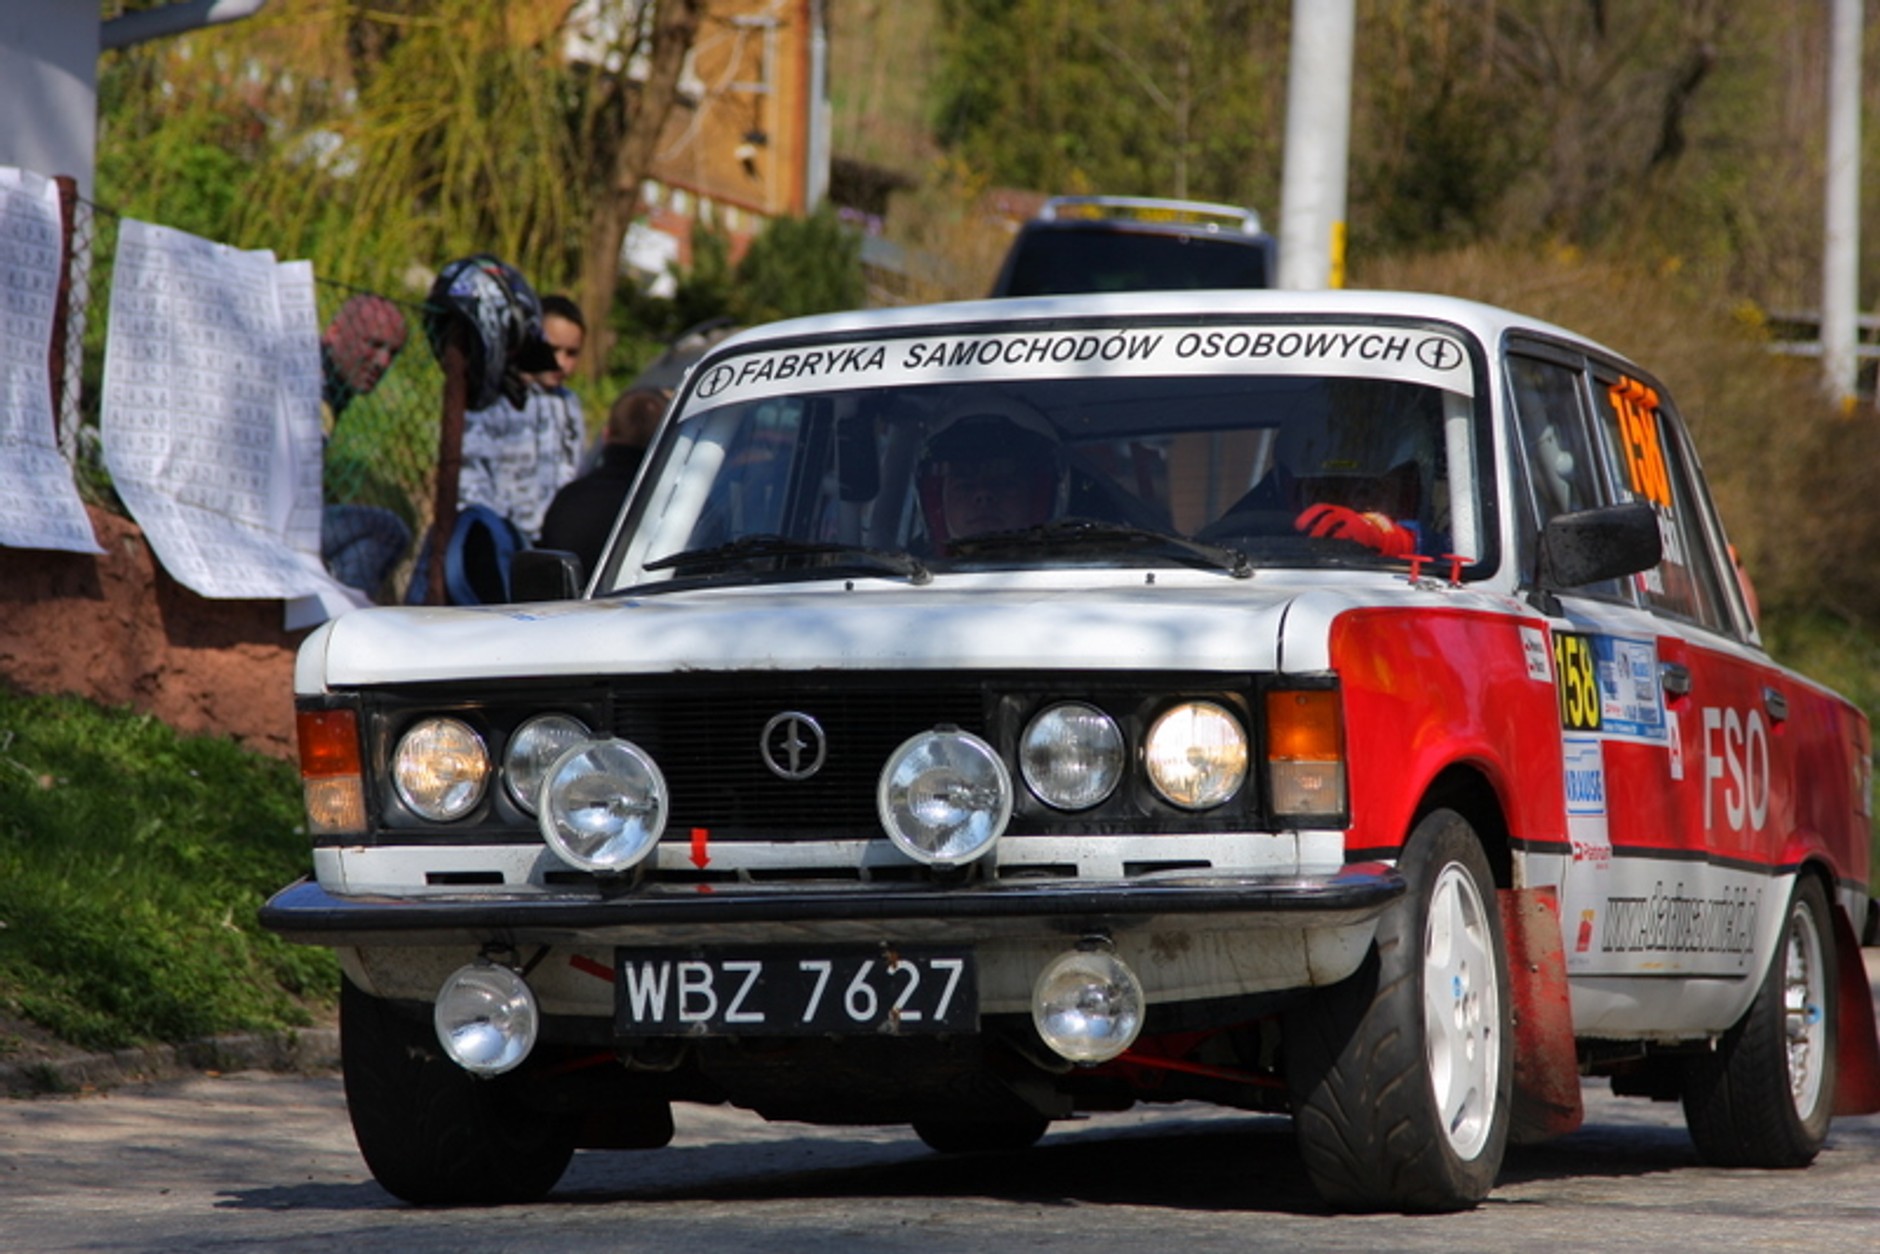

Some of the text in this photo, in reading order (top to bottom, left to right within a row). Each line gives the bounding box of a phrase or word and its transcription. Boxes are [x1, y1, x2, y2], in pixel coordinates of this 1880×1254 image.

[734, 329, 1411, 387] FABRYKA SAMOCHODÓW OSOBOWYCH
[1555, 633, 1600, 728] 158
[1701, 707, 1769, 832] FSO
[624, 958, 965, 1023] WBZ 7627
